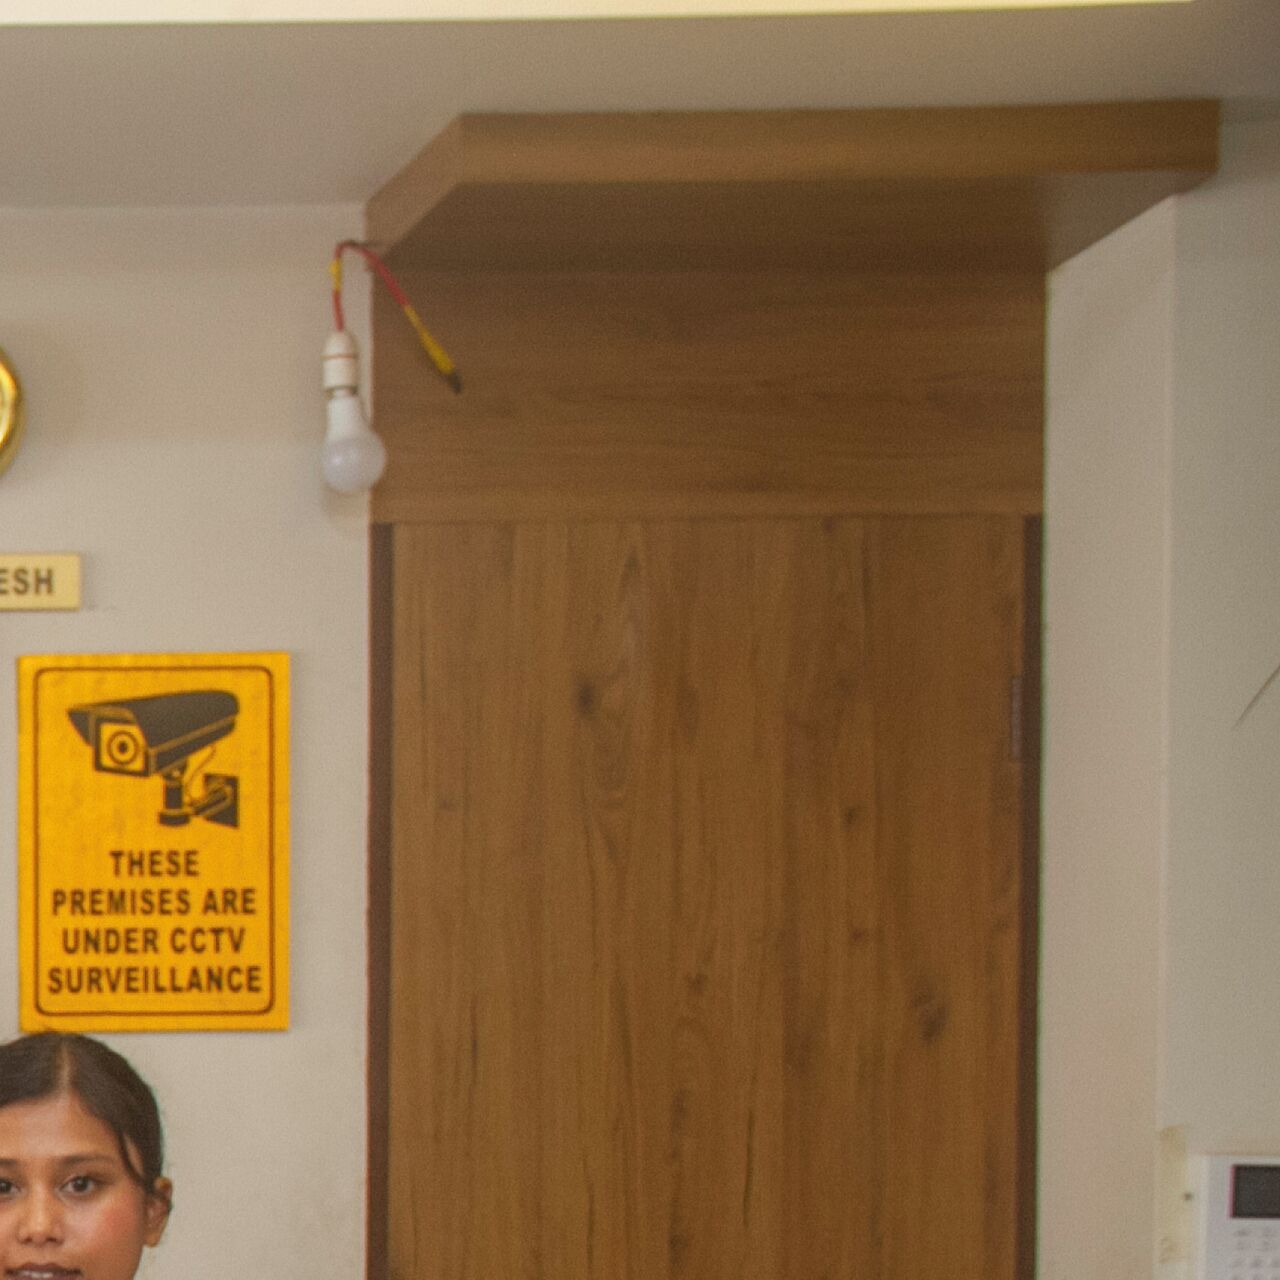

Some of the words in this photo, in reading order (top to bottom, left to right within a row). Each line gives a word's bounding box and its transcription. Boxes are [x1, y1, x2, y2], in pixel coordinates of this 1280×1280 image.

[109, 850, 200, 877] THESE
[51, 888, 191, 916] PREMISES
[203, 888, 257, 915] ARE
[62, 927, 159, 955] UNDER
[170, 926, 245, 954] CCTV
[47, 965, 262, 995] SURVEILLANCE
